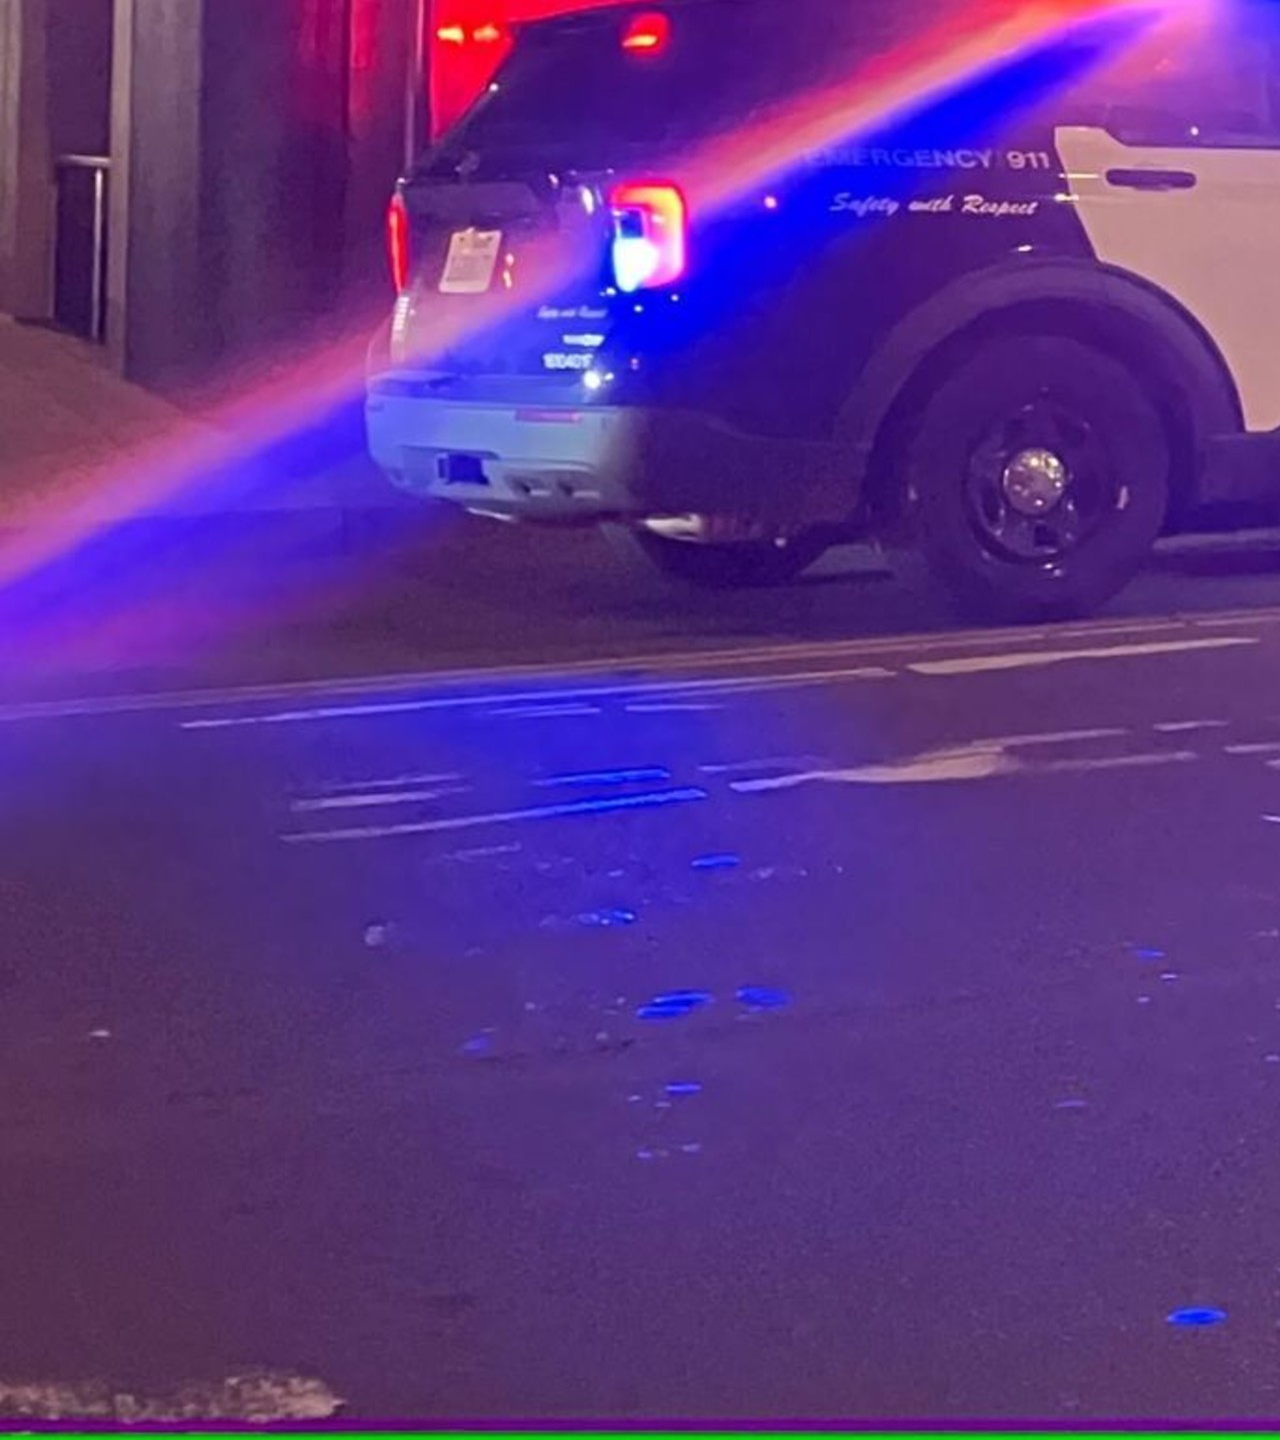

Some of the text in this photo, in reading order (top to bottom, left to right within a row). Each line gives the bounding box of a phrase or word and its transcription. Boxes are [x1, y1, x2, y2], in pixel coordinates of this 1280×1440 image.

[810, 147, 1051, 170] EMERGENCY 911
[829, 191, 1039, 218] Safety with Respect
